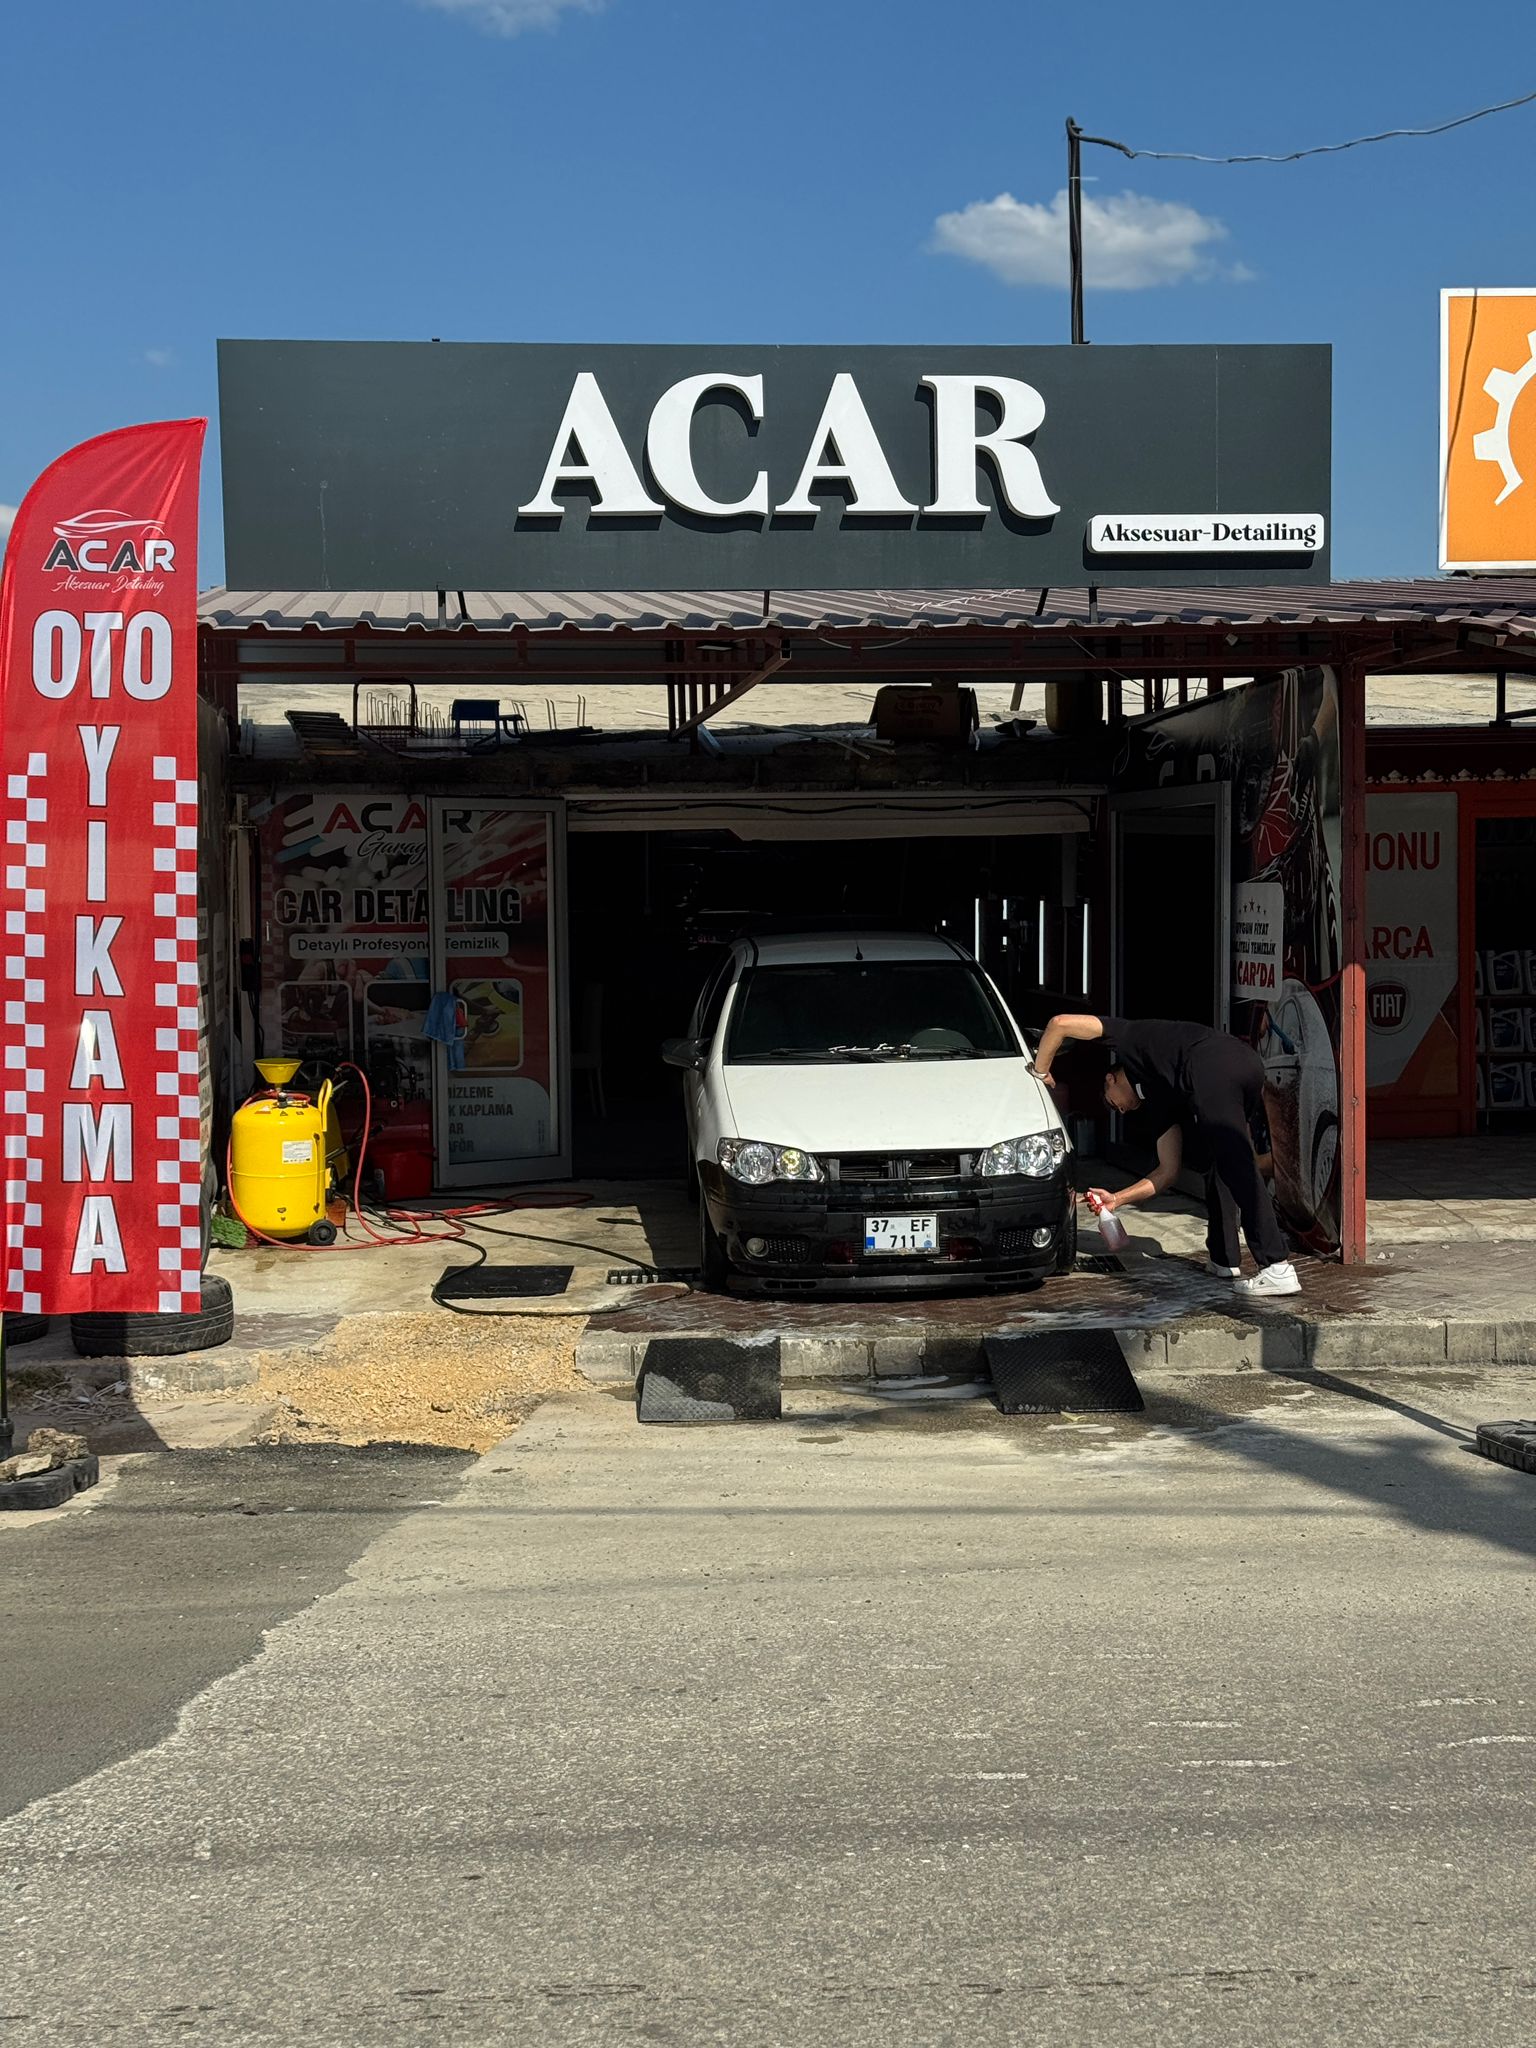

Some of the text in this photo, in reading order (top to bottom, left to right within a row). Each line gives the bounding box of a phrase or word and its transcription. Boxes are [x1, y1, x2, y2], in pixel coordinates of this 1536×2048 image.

[518, 372, 1061, 520] ACAR
[1100, 522, 1317, 548] Aksesuar-Detailing
[41, 538, 177, 573] ACAR
[51, 574, 165, 597] Aksesuar Detailing
[32, 610, 173, 700] OTO
[321, 802, 473, 834] ACAR
[357, 831, 427, 865] Garag
[274, 888, 522, 925] CAR DETALING
[298, 937, 349, 954] Detaylı
[445, 935, 500, 951] Temizlik
[62, 723, 134, 1275] YIKAMA
[1372, 993, 1403, 1019] FIAT
[459, 1103, 514, 1117] KAPLAMA
[871, 1218, 931, 1232] 37 EF
[889, 1234, 916, 1248] 711
